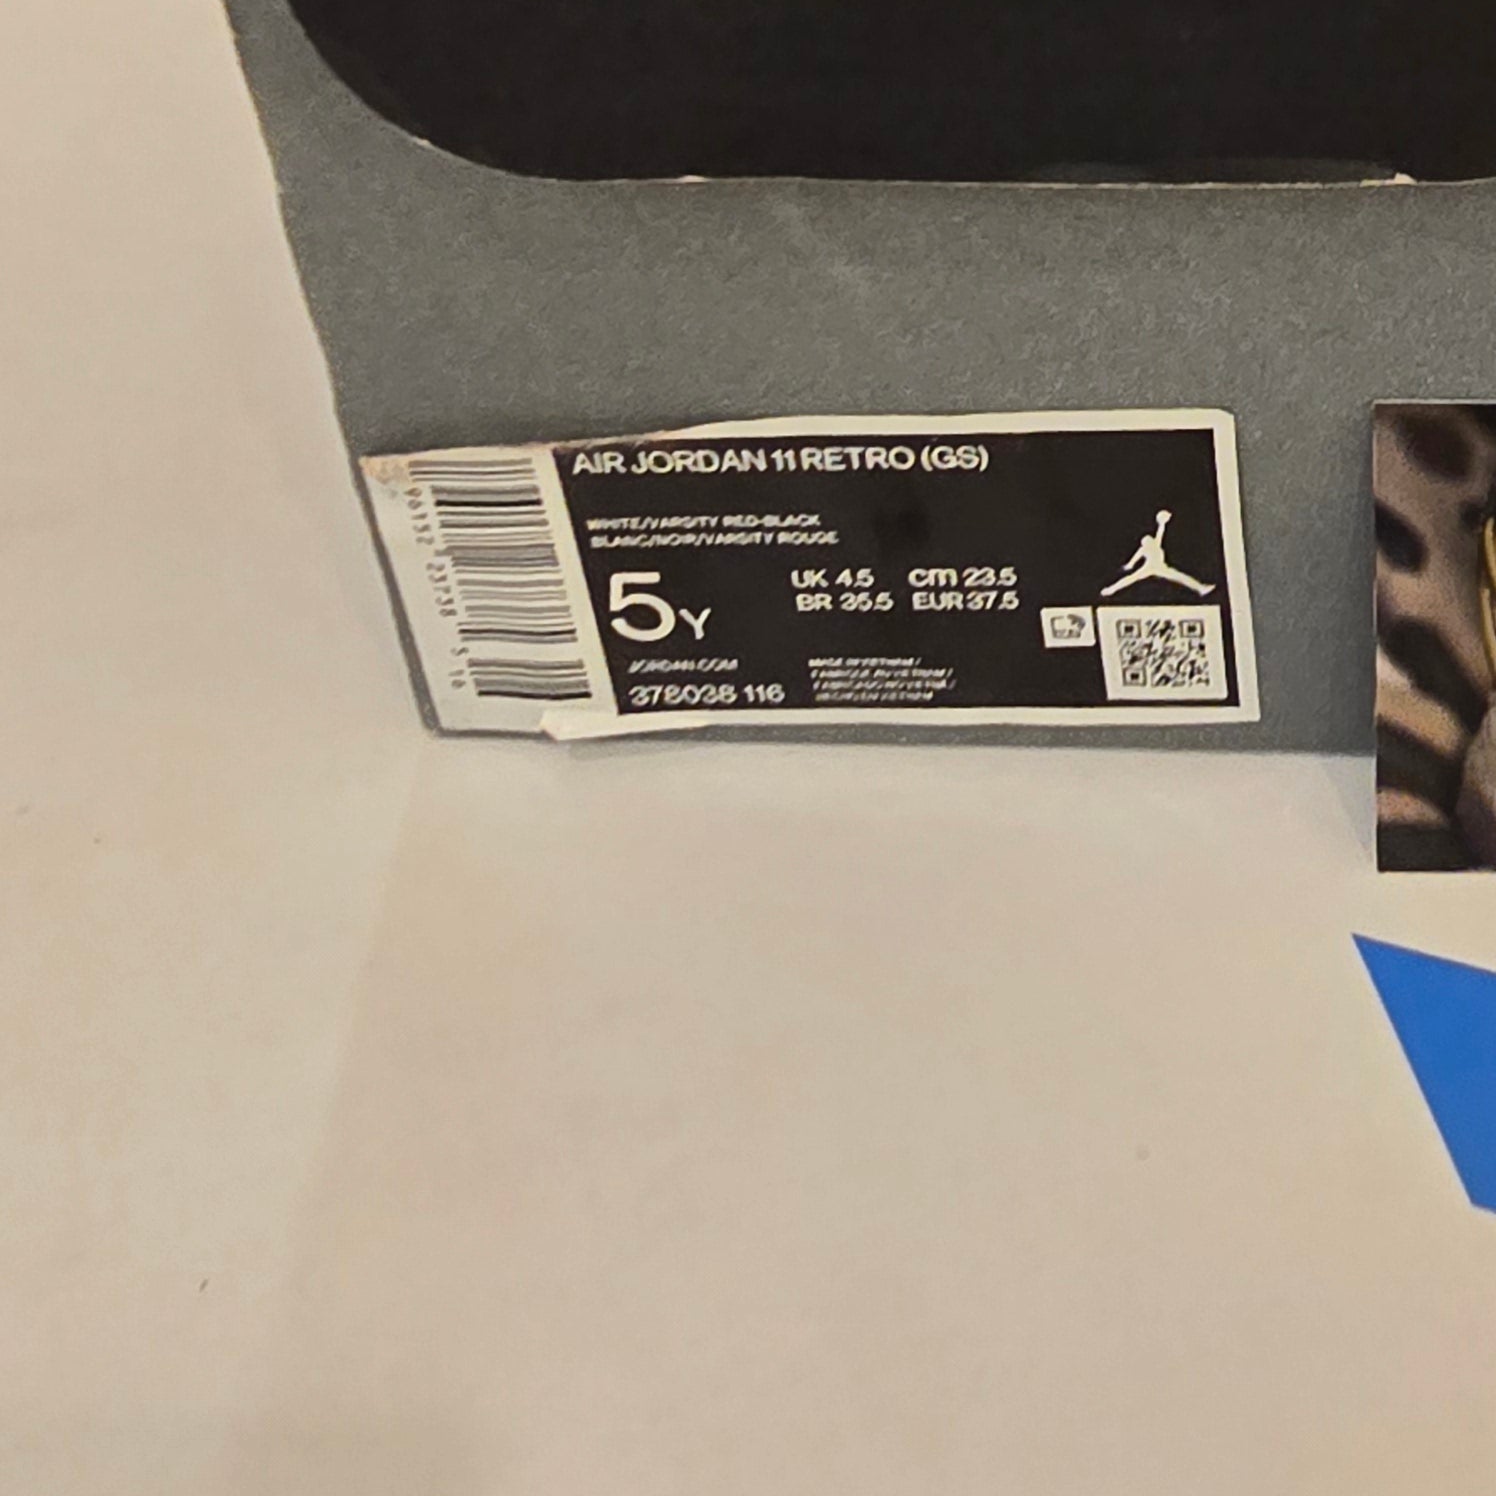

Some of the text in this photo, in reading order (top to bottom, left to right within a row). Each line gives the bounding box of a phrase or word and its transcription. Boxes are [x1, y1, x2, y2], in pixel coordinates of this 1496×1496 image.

[572, 444, 990, 474] AIR JORDAN 11 RETRO (GS)
[790, 568, 829, 589] UK
[962, 566, 1019, 588] 23.5
[795, 592, 834, 612] BR
[911, 590, 1020, 611] EUR 37.5
[627, 682, 786, 706] 378038 116
